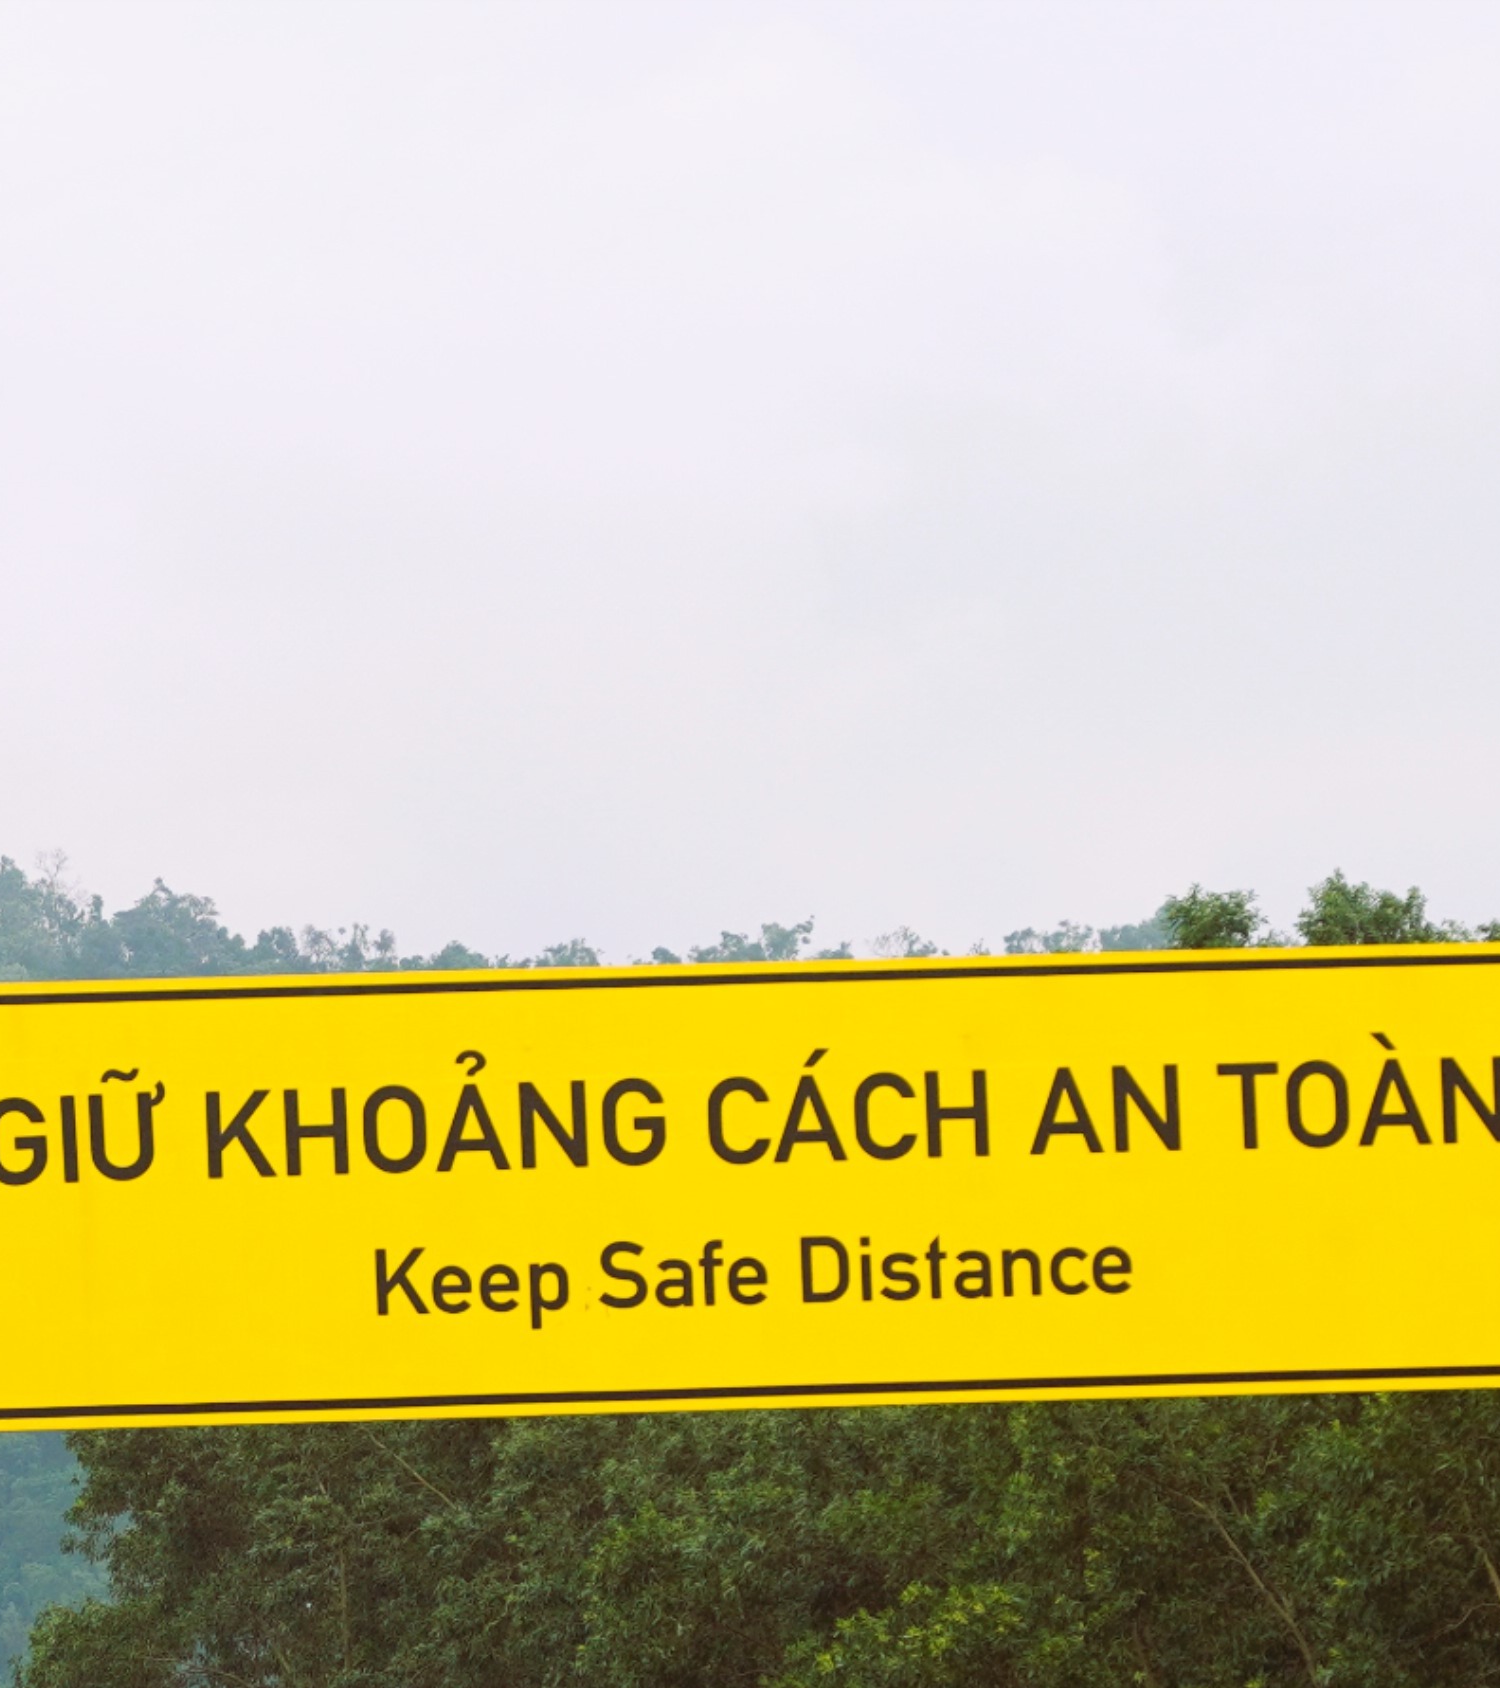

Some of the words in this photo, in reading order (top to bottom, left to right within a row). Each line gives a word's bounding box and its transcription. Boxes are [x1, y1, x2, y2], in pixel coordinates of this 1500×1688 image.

[204, 1049, 667, 1180] KHOẢNG
[706, 1047, 991, 1166] CÁCH
[1029, 1063, 1182, 1156] AN
[374, 1246, 571, 1331] Keep
[598, 1238, 769, 1310] Safe
[799, 1235, 1134, 1304] Distance
